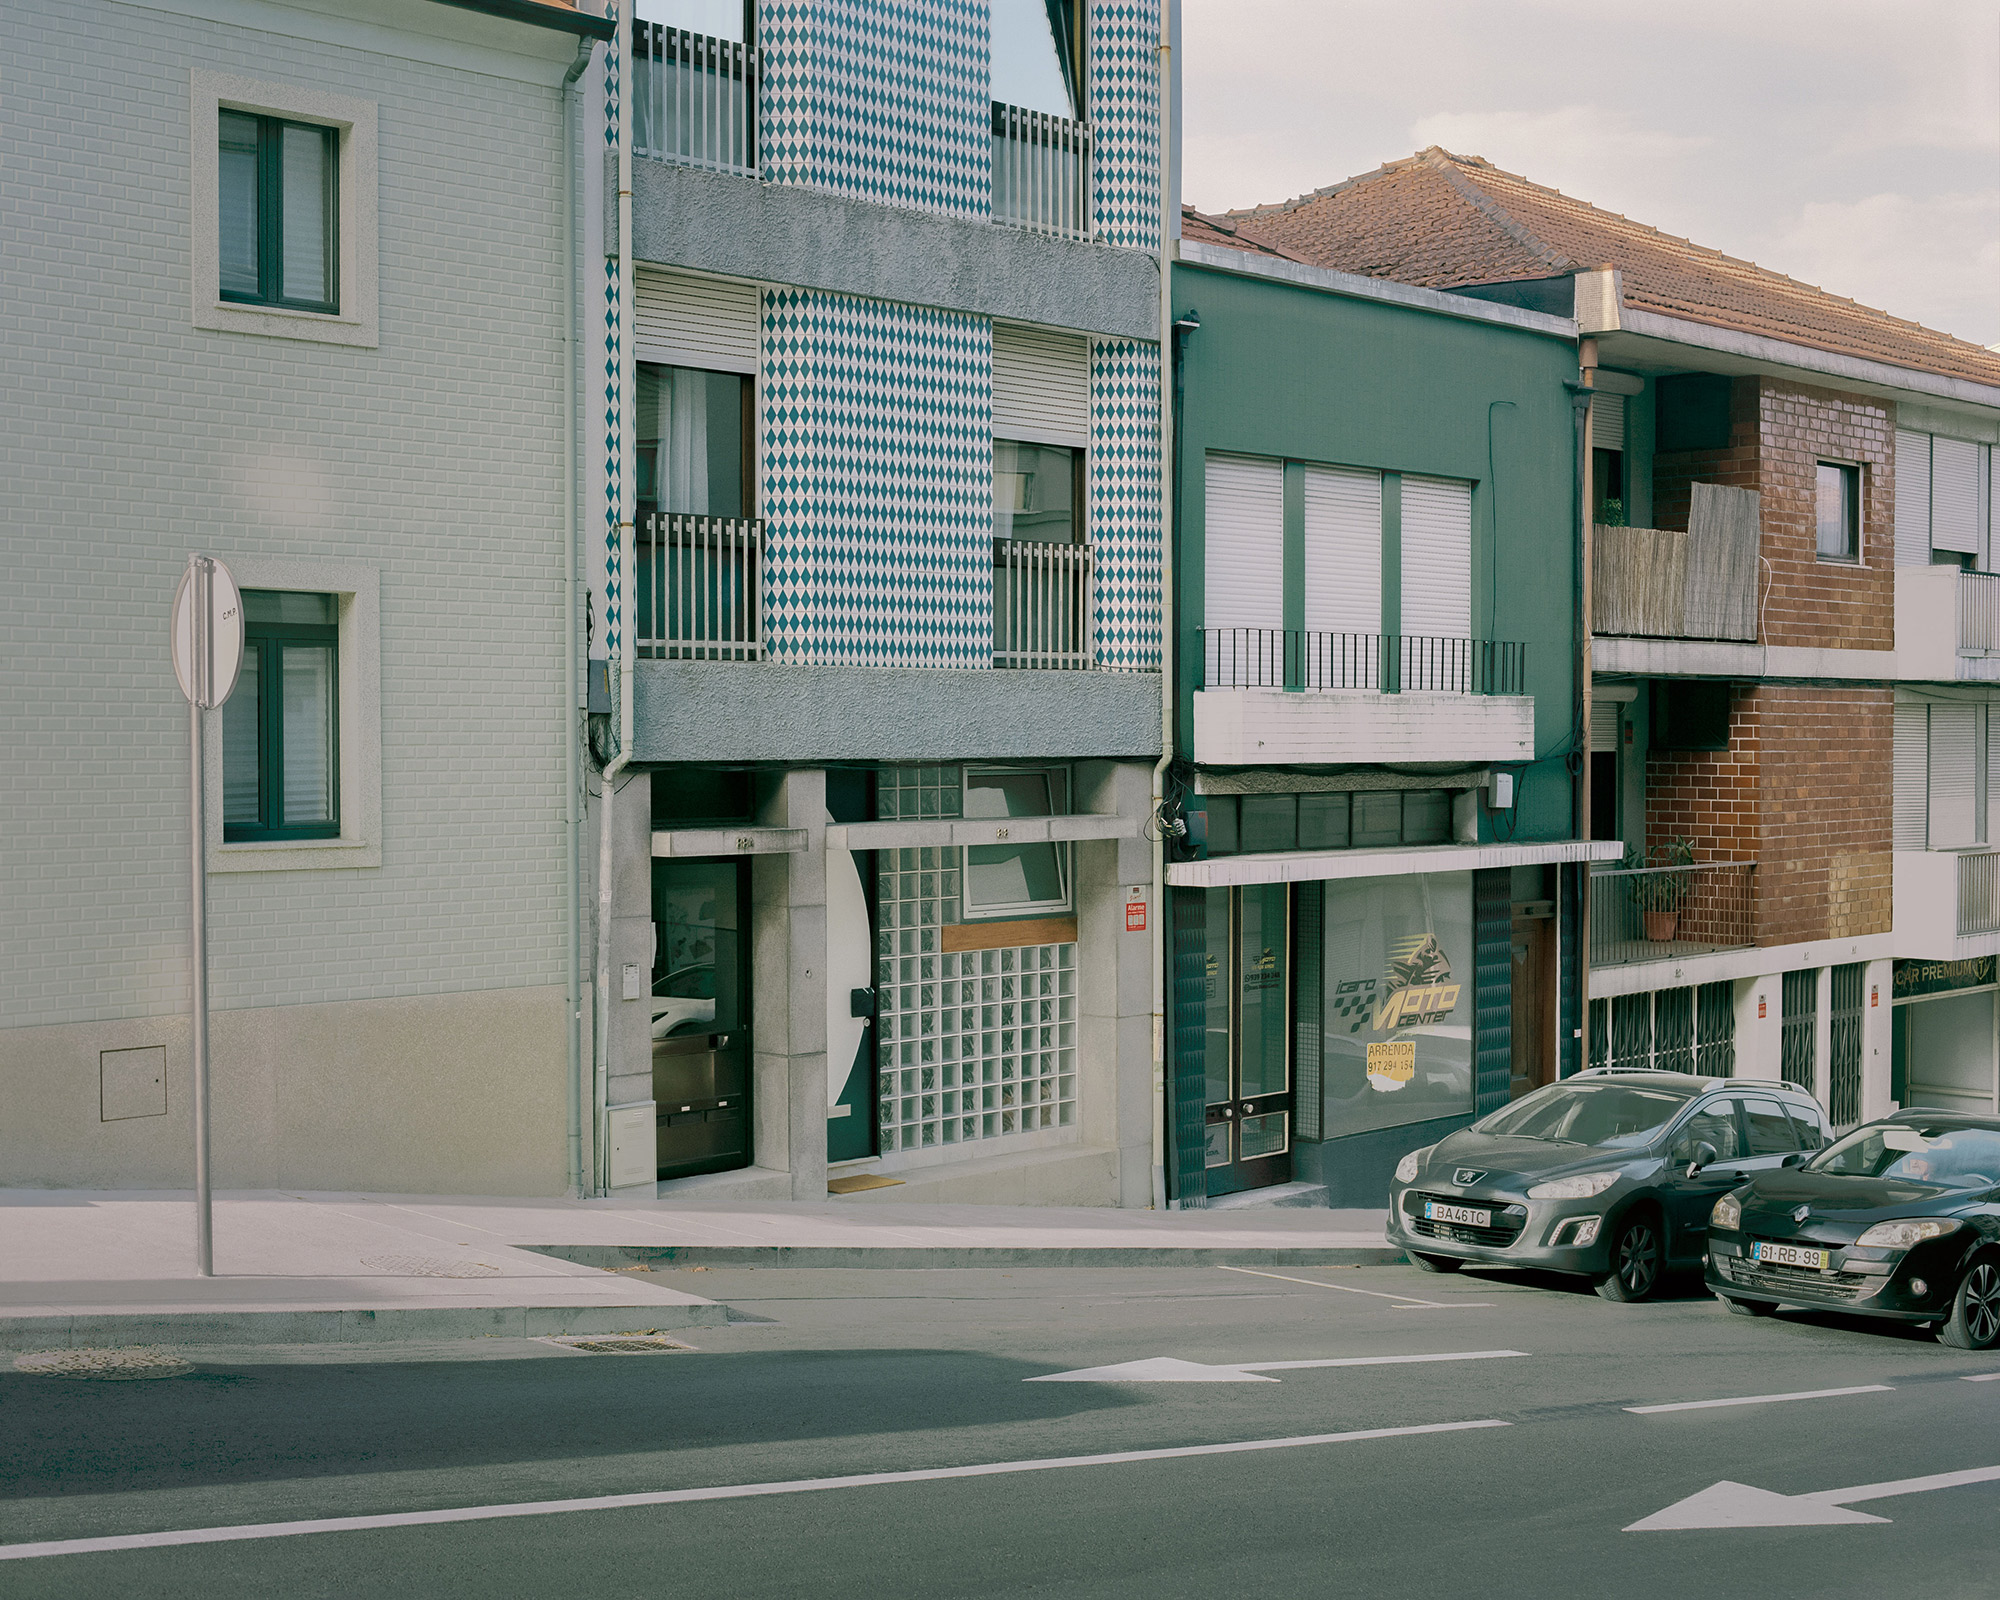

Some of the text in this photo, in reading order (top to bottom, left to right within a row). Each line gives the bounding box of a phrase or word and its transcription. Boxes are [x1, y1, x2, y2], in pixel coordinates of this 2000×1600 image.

[996, 827, 1009, 839] 88
[1895, 959, 1971, 985] CAR PREMIUM
[1371, 984, 1461, 1031] MOTO
[1368, 1044, 1414, 1057] ARRENDA
[1368, 1060, 1413, 1072] 917 294 154
[1436, 1206, 1485, 1224] BA46TC
